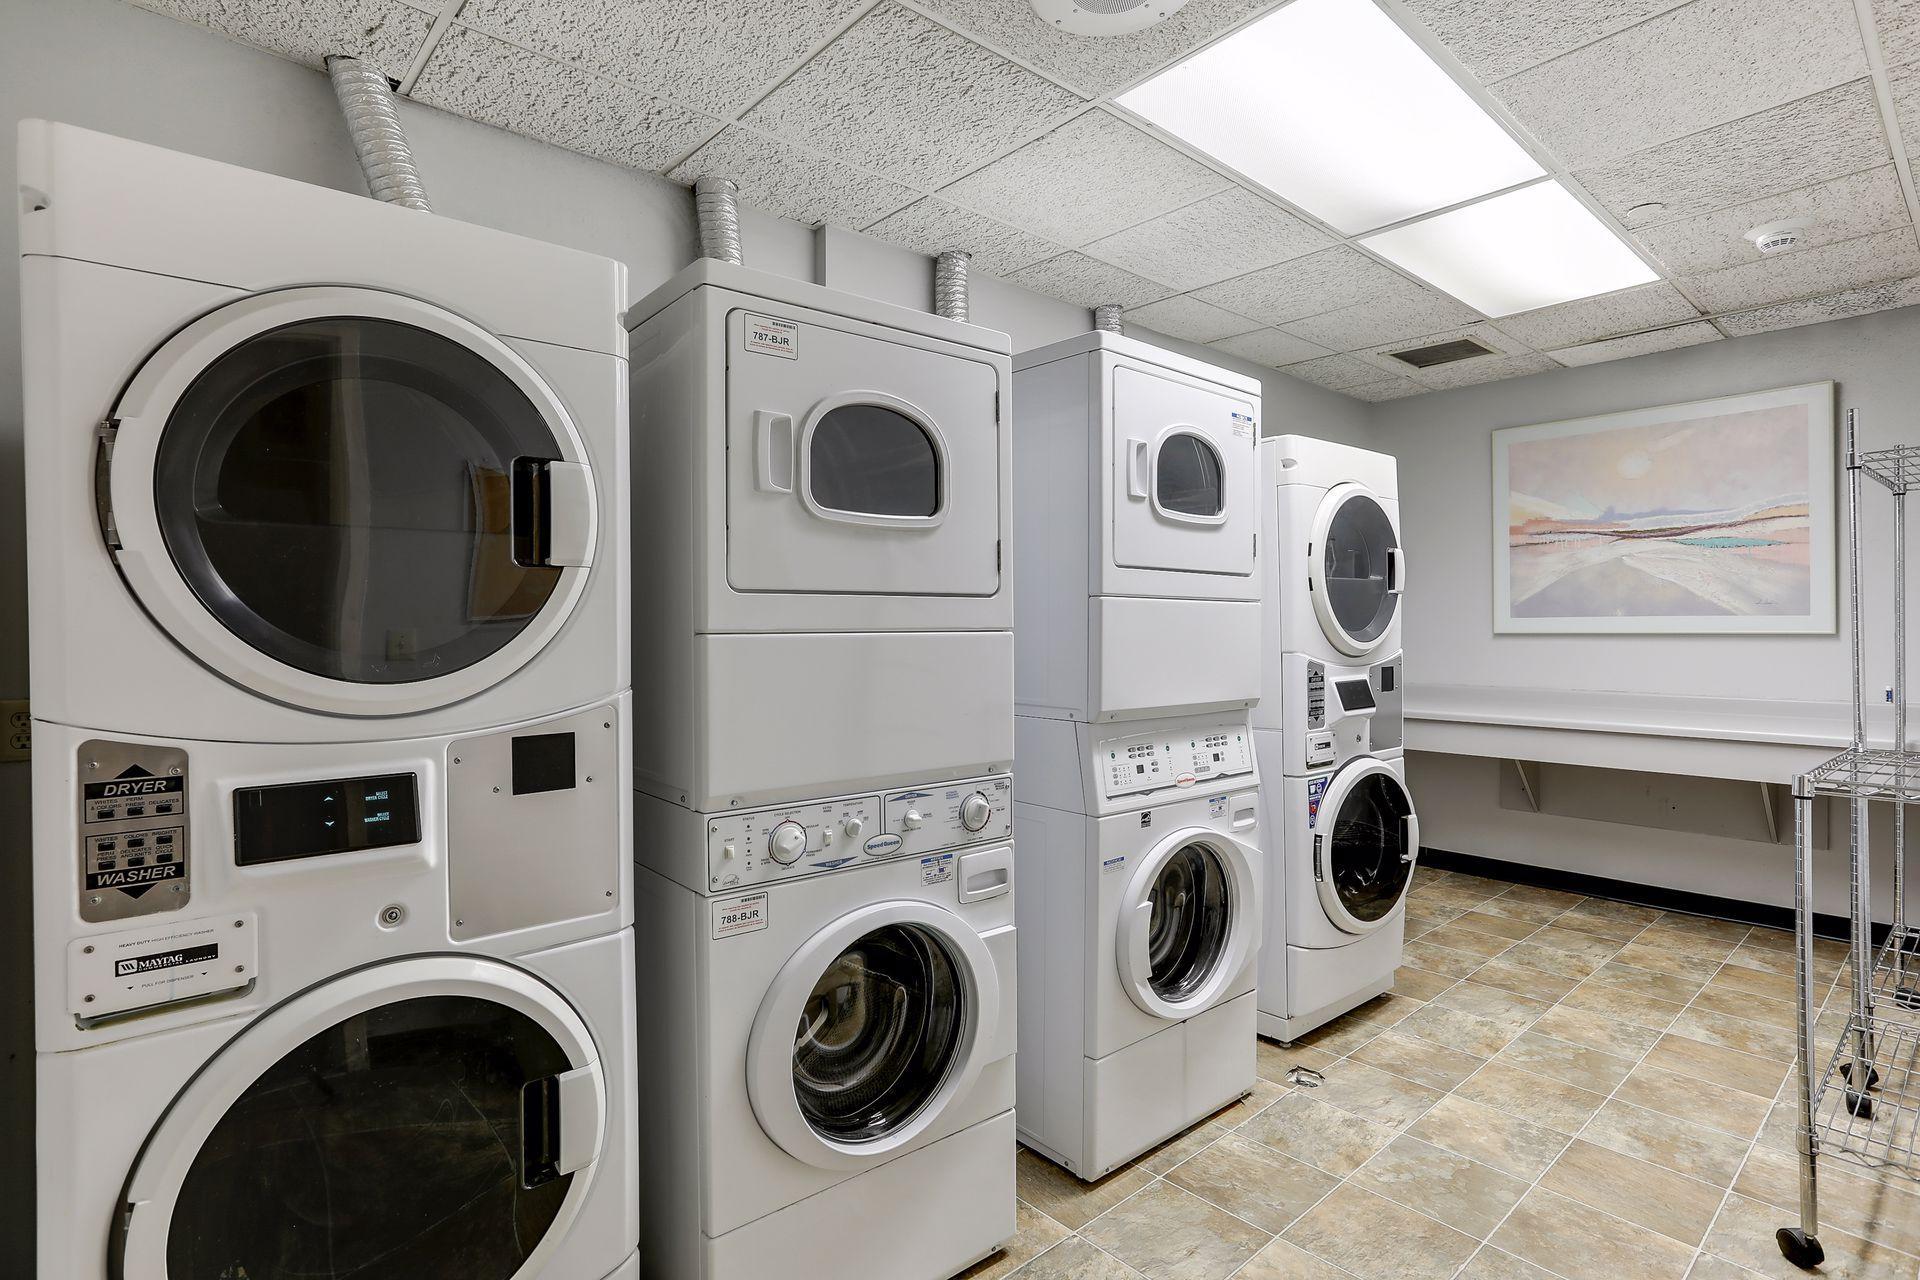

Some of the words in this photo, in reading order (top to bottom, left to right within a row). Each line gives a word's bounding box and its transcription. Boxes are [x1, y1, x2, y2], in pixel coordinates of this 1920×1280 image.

[753, 331, 790, 346] 787-BJR
[104, 780, 167, 796] DRYER
[867, 842, 883, 850] Speed
[97, 865, 176, 886] WASHER
[721, 910, 759, 925] 788-BJR
[165, 932, 193, 940] EFFICIENCY
[138, 954, 183, 968] MAYTAG
[138, 961, 183, 971] COMMERCIAL
[186, 954, 216, 963] LAUNDRY
[167, 974, 194, 983] DISPENSER
